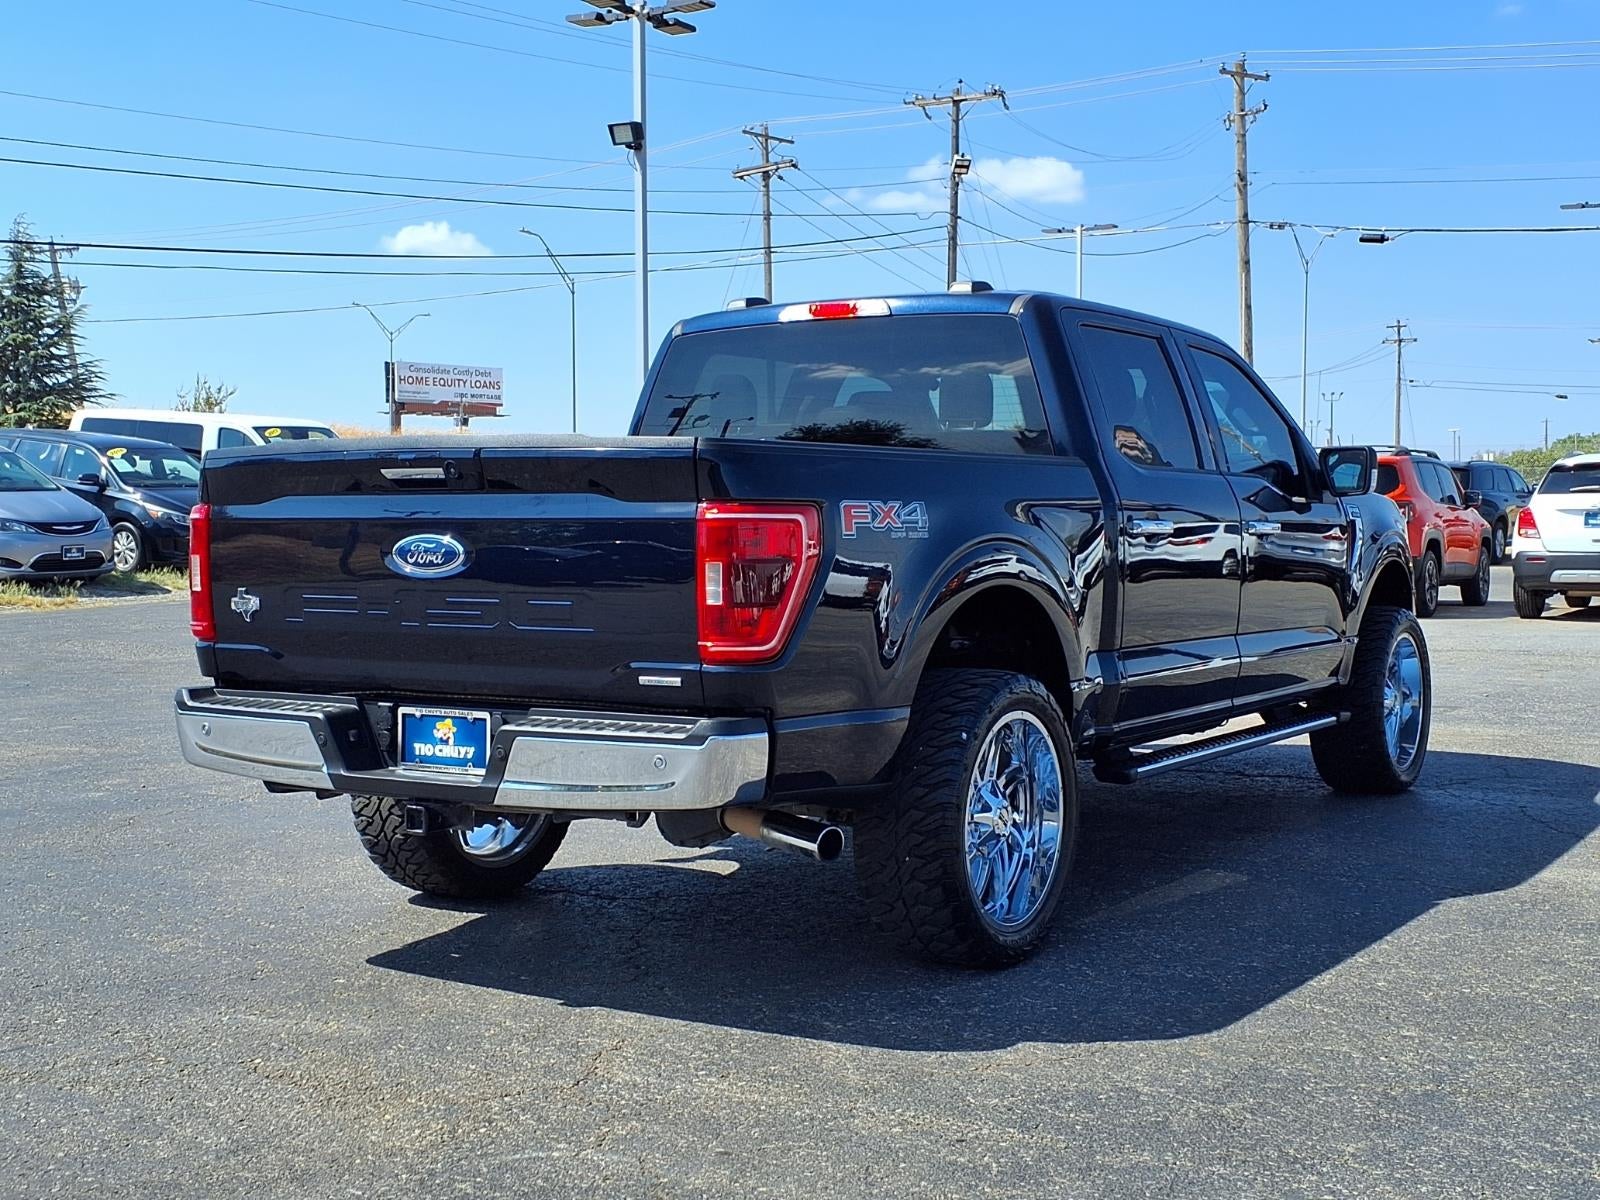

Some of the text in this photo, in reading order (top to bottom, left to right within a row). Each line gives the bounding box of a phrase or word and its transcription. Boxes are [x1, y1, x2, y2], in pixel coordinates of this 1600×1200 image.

[408, 364, 492, 378] Consolidate Costly Debt
[398, 375, 501, 390] HOME EQUITY LOANS
[470, 392, 502, 401] MORTGAGE
[840, 499, 928, 538] FX4
[407, 542, 446, 564] Ford
[413, 742, 434, 756] TIO
